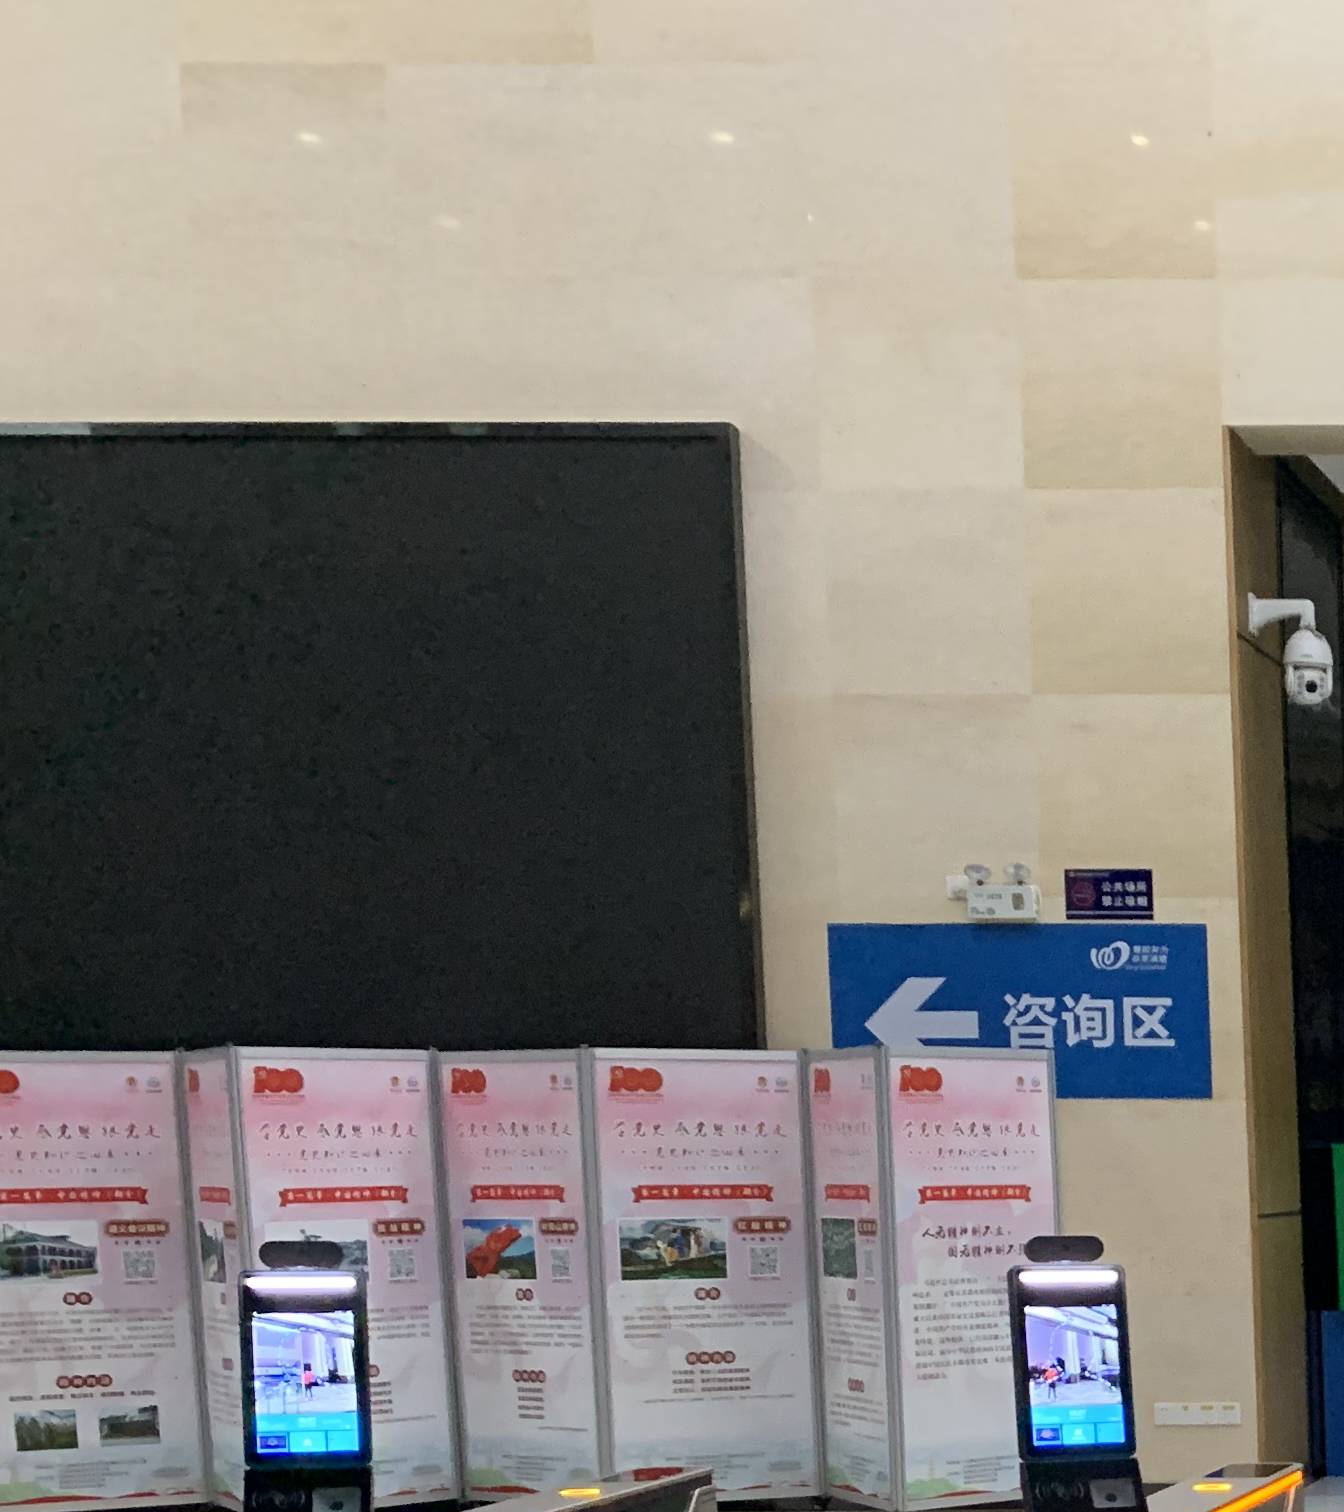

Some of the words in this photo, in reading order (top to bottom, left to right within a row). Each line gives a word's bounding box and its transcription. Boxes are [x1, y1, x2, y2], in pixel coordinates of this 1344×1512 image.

[1101, 881, 1147, 893] 公共场所
[1003, 993, 1175, 1048] 咨询区
